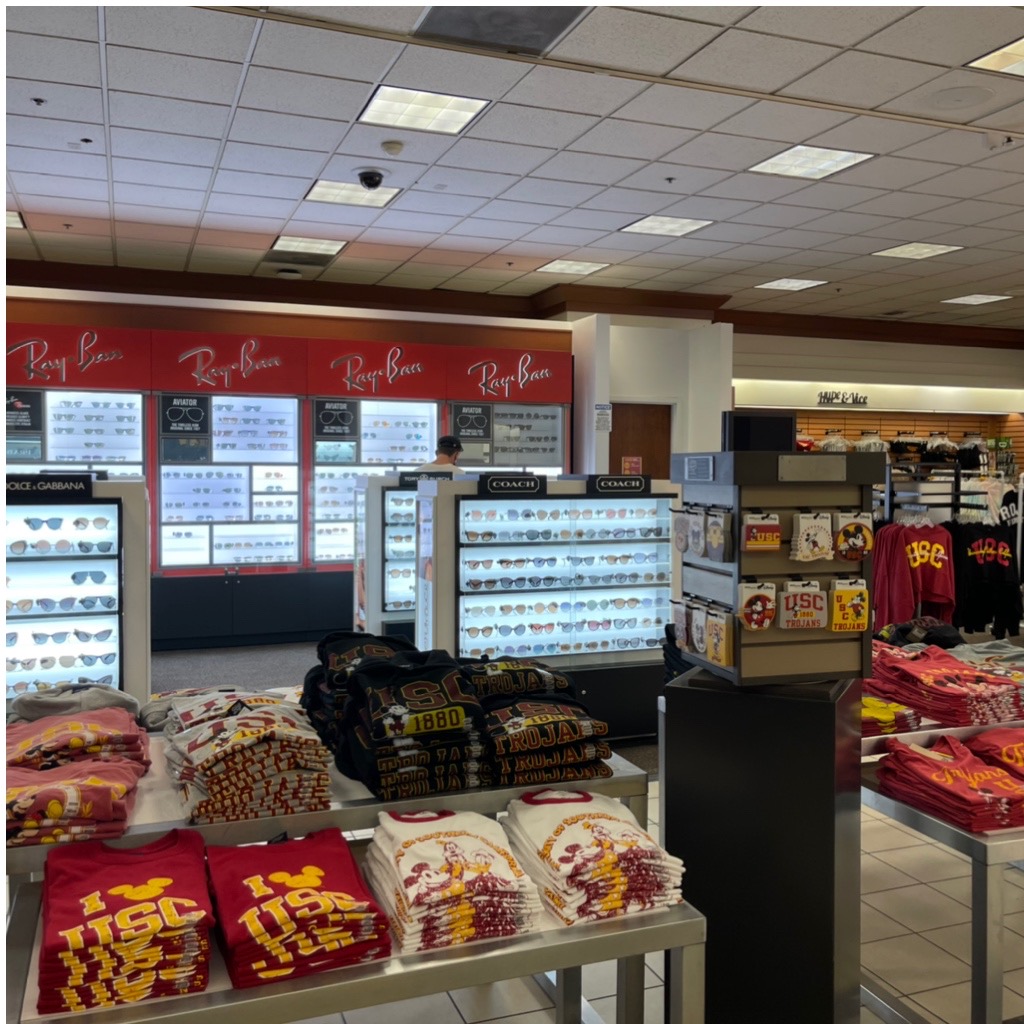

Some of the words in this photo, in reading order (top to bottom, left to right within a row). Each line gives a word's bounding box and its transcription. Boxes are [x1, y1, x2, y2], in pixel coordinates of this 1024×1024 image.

[172, 398, 198, 406] AVIATOR
[6, 481, 32, 490] OLCE
[36, 481, 85, 490] GABBANA
[492, 480, 535, 488] COACH
[757, 532, 781, 541] USC
[905, 540, 945, 569] USC
[784, 592, 824, 611] USC
[785, 619, 821, 628] TROJANS
[471, 671, 569, 695] TROJAS
[413, 708, 461, 732] 1880
